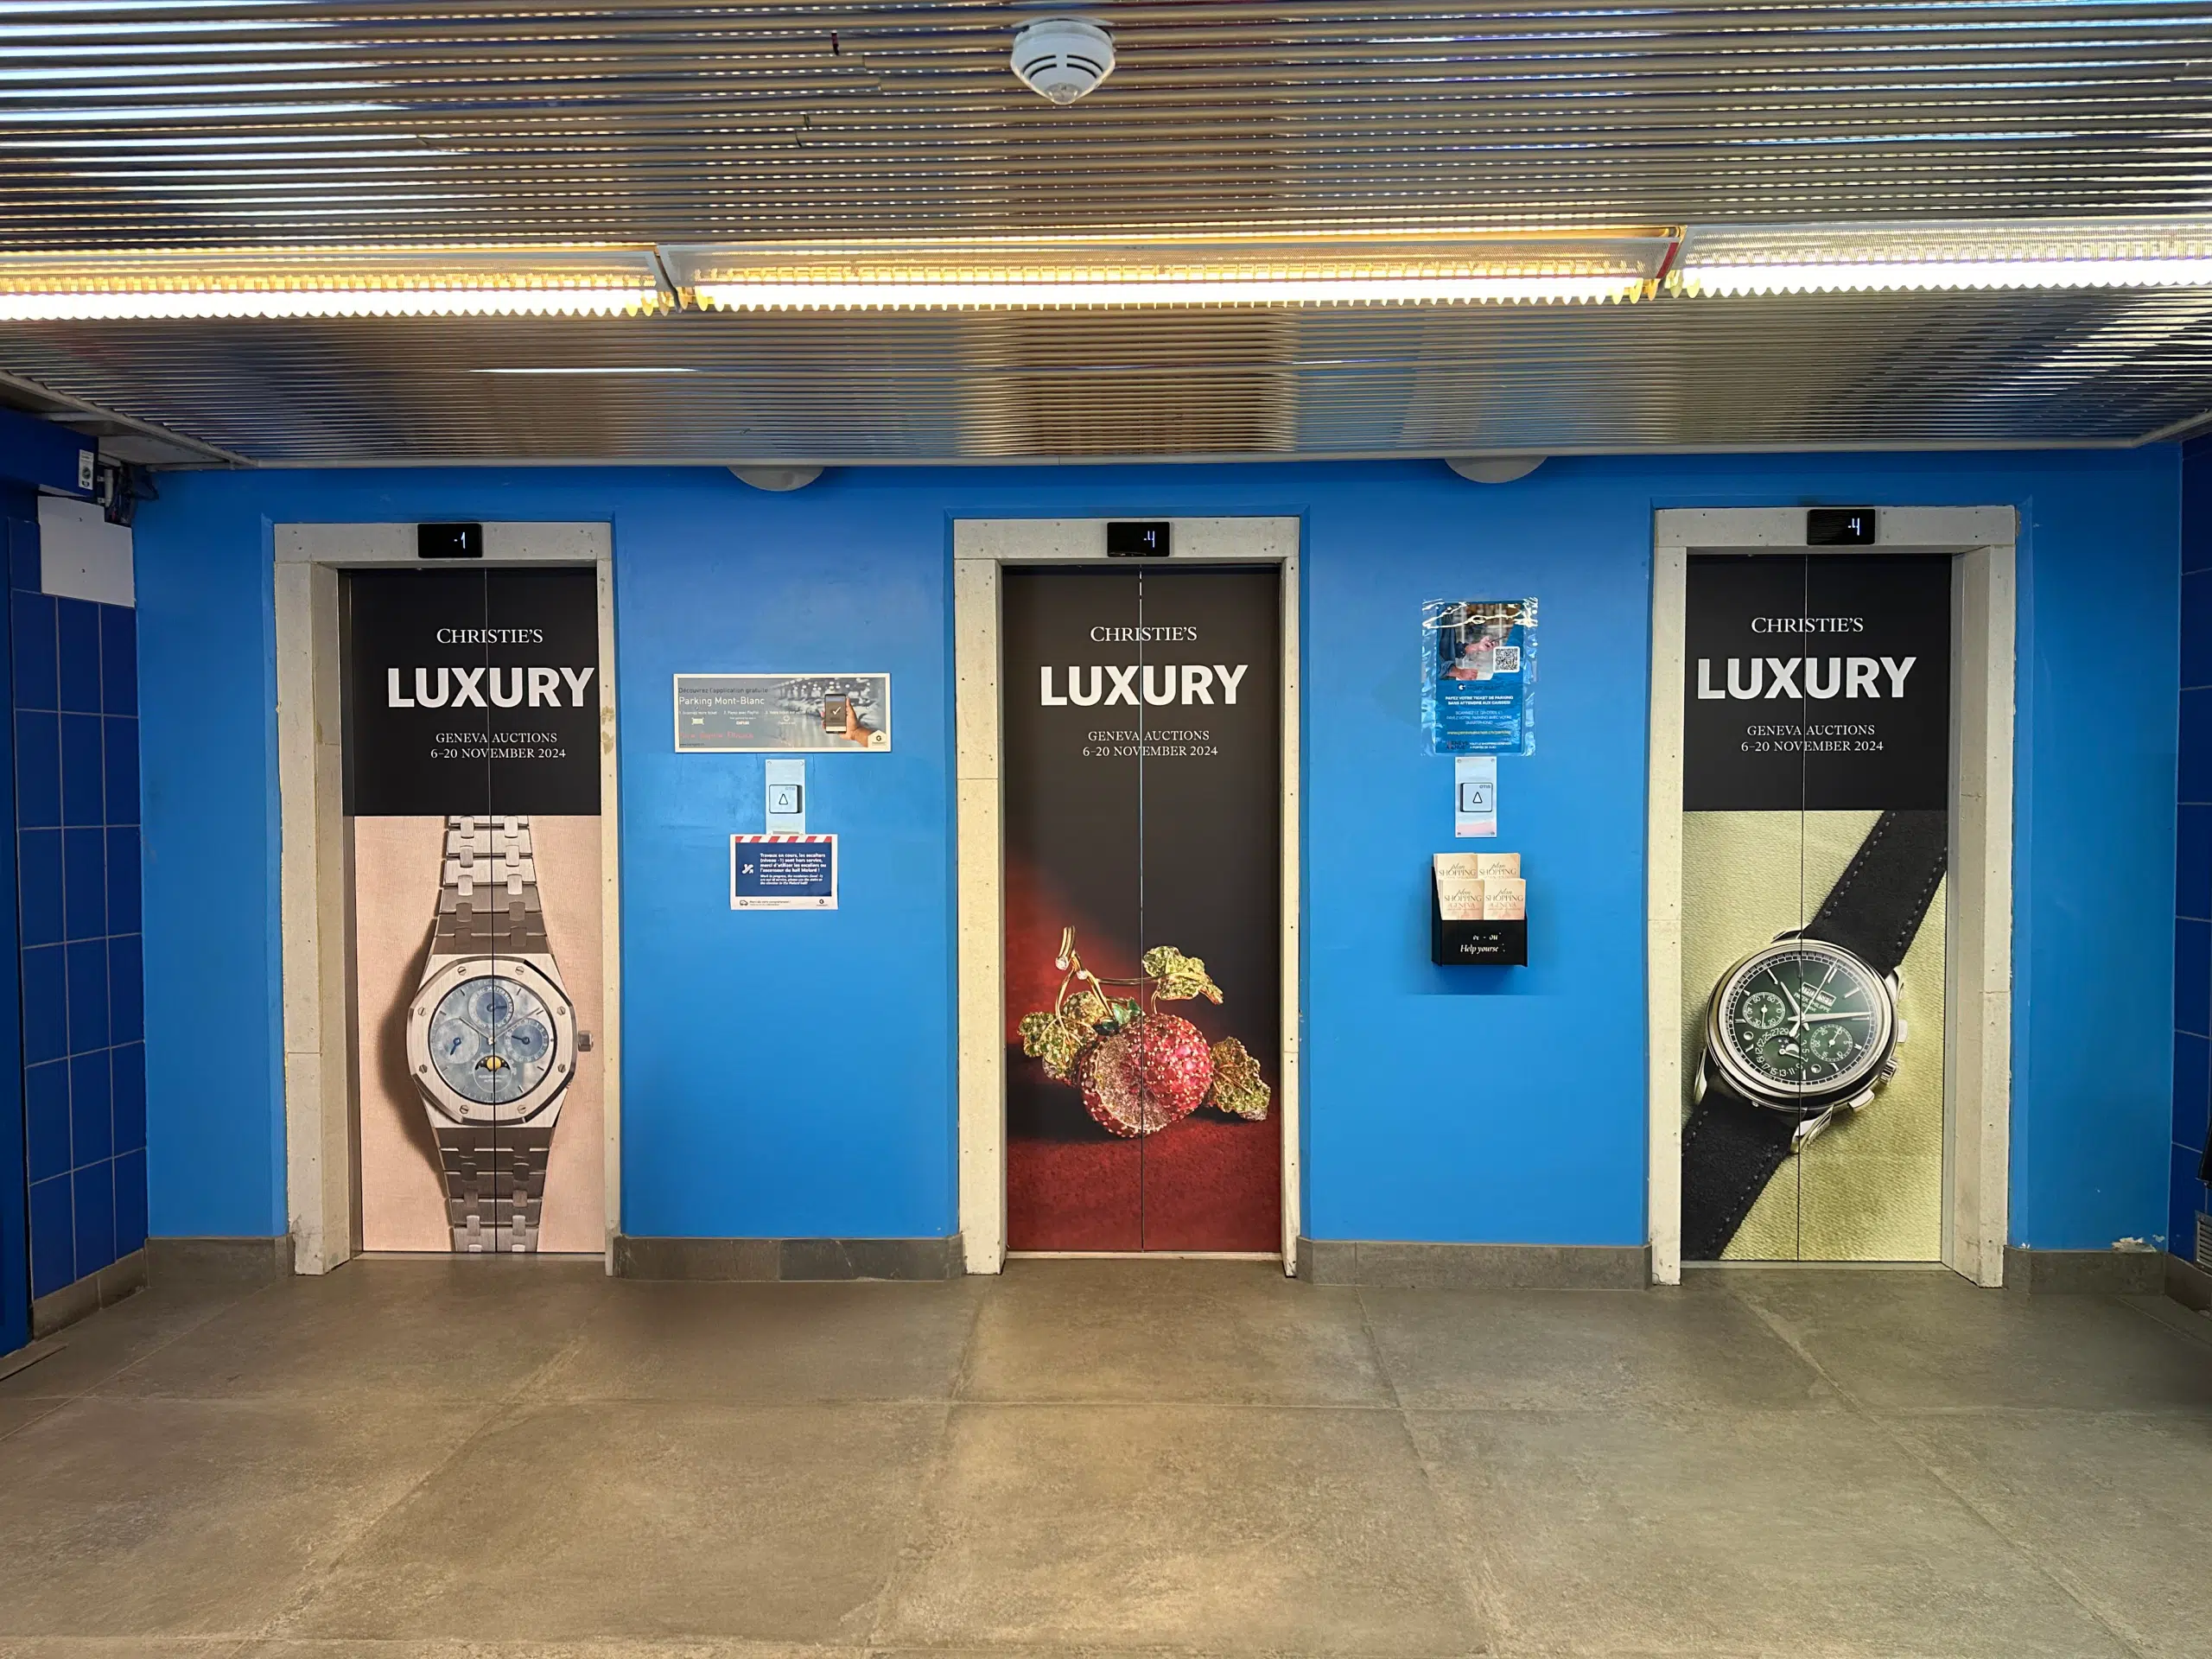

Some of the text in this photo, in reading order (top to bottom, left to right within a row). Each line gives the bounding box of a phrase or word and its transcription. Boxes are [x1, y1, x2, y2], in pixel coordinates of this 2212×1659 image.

[1847, 518, 1860, 537] -4
[454, 531, 466, 550] -1
[1143, 531, 1155, 548] -4
[1751, 616, 1864, 633] CHRISTIE'S
[436, 628, 543, 644] CHRISTIE'S
[1090, 626, 1198, 643] CHRISTIE'S
[1697, 657, 1917, 700] LUXURY
[387, 667, 595, 709] LUXURY
[1040, 664, 1249, 707] LUXURY
[679, 696, 765, 707] Parking Mont-Blanc
[1088, 730, 1210, 741] GENEVA AUCTIONS
[1746, 725, 1875, 736] GENEVA AUCTIONS
[435, 733, 557, 743] GENEVA AUCTIONS
[1083, 746, 1219, 756] 6-20 NOVEMBER 2024
[1741, 741, 1884, 752] 6-20 NOVEMBER 2024
[430, 748, 567, 759] 6-20 NOVEMBER 2024
[1460, 944, 1477, 954] Help
[1771, 1028, 1779, 1036] 27
